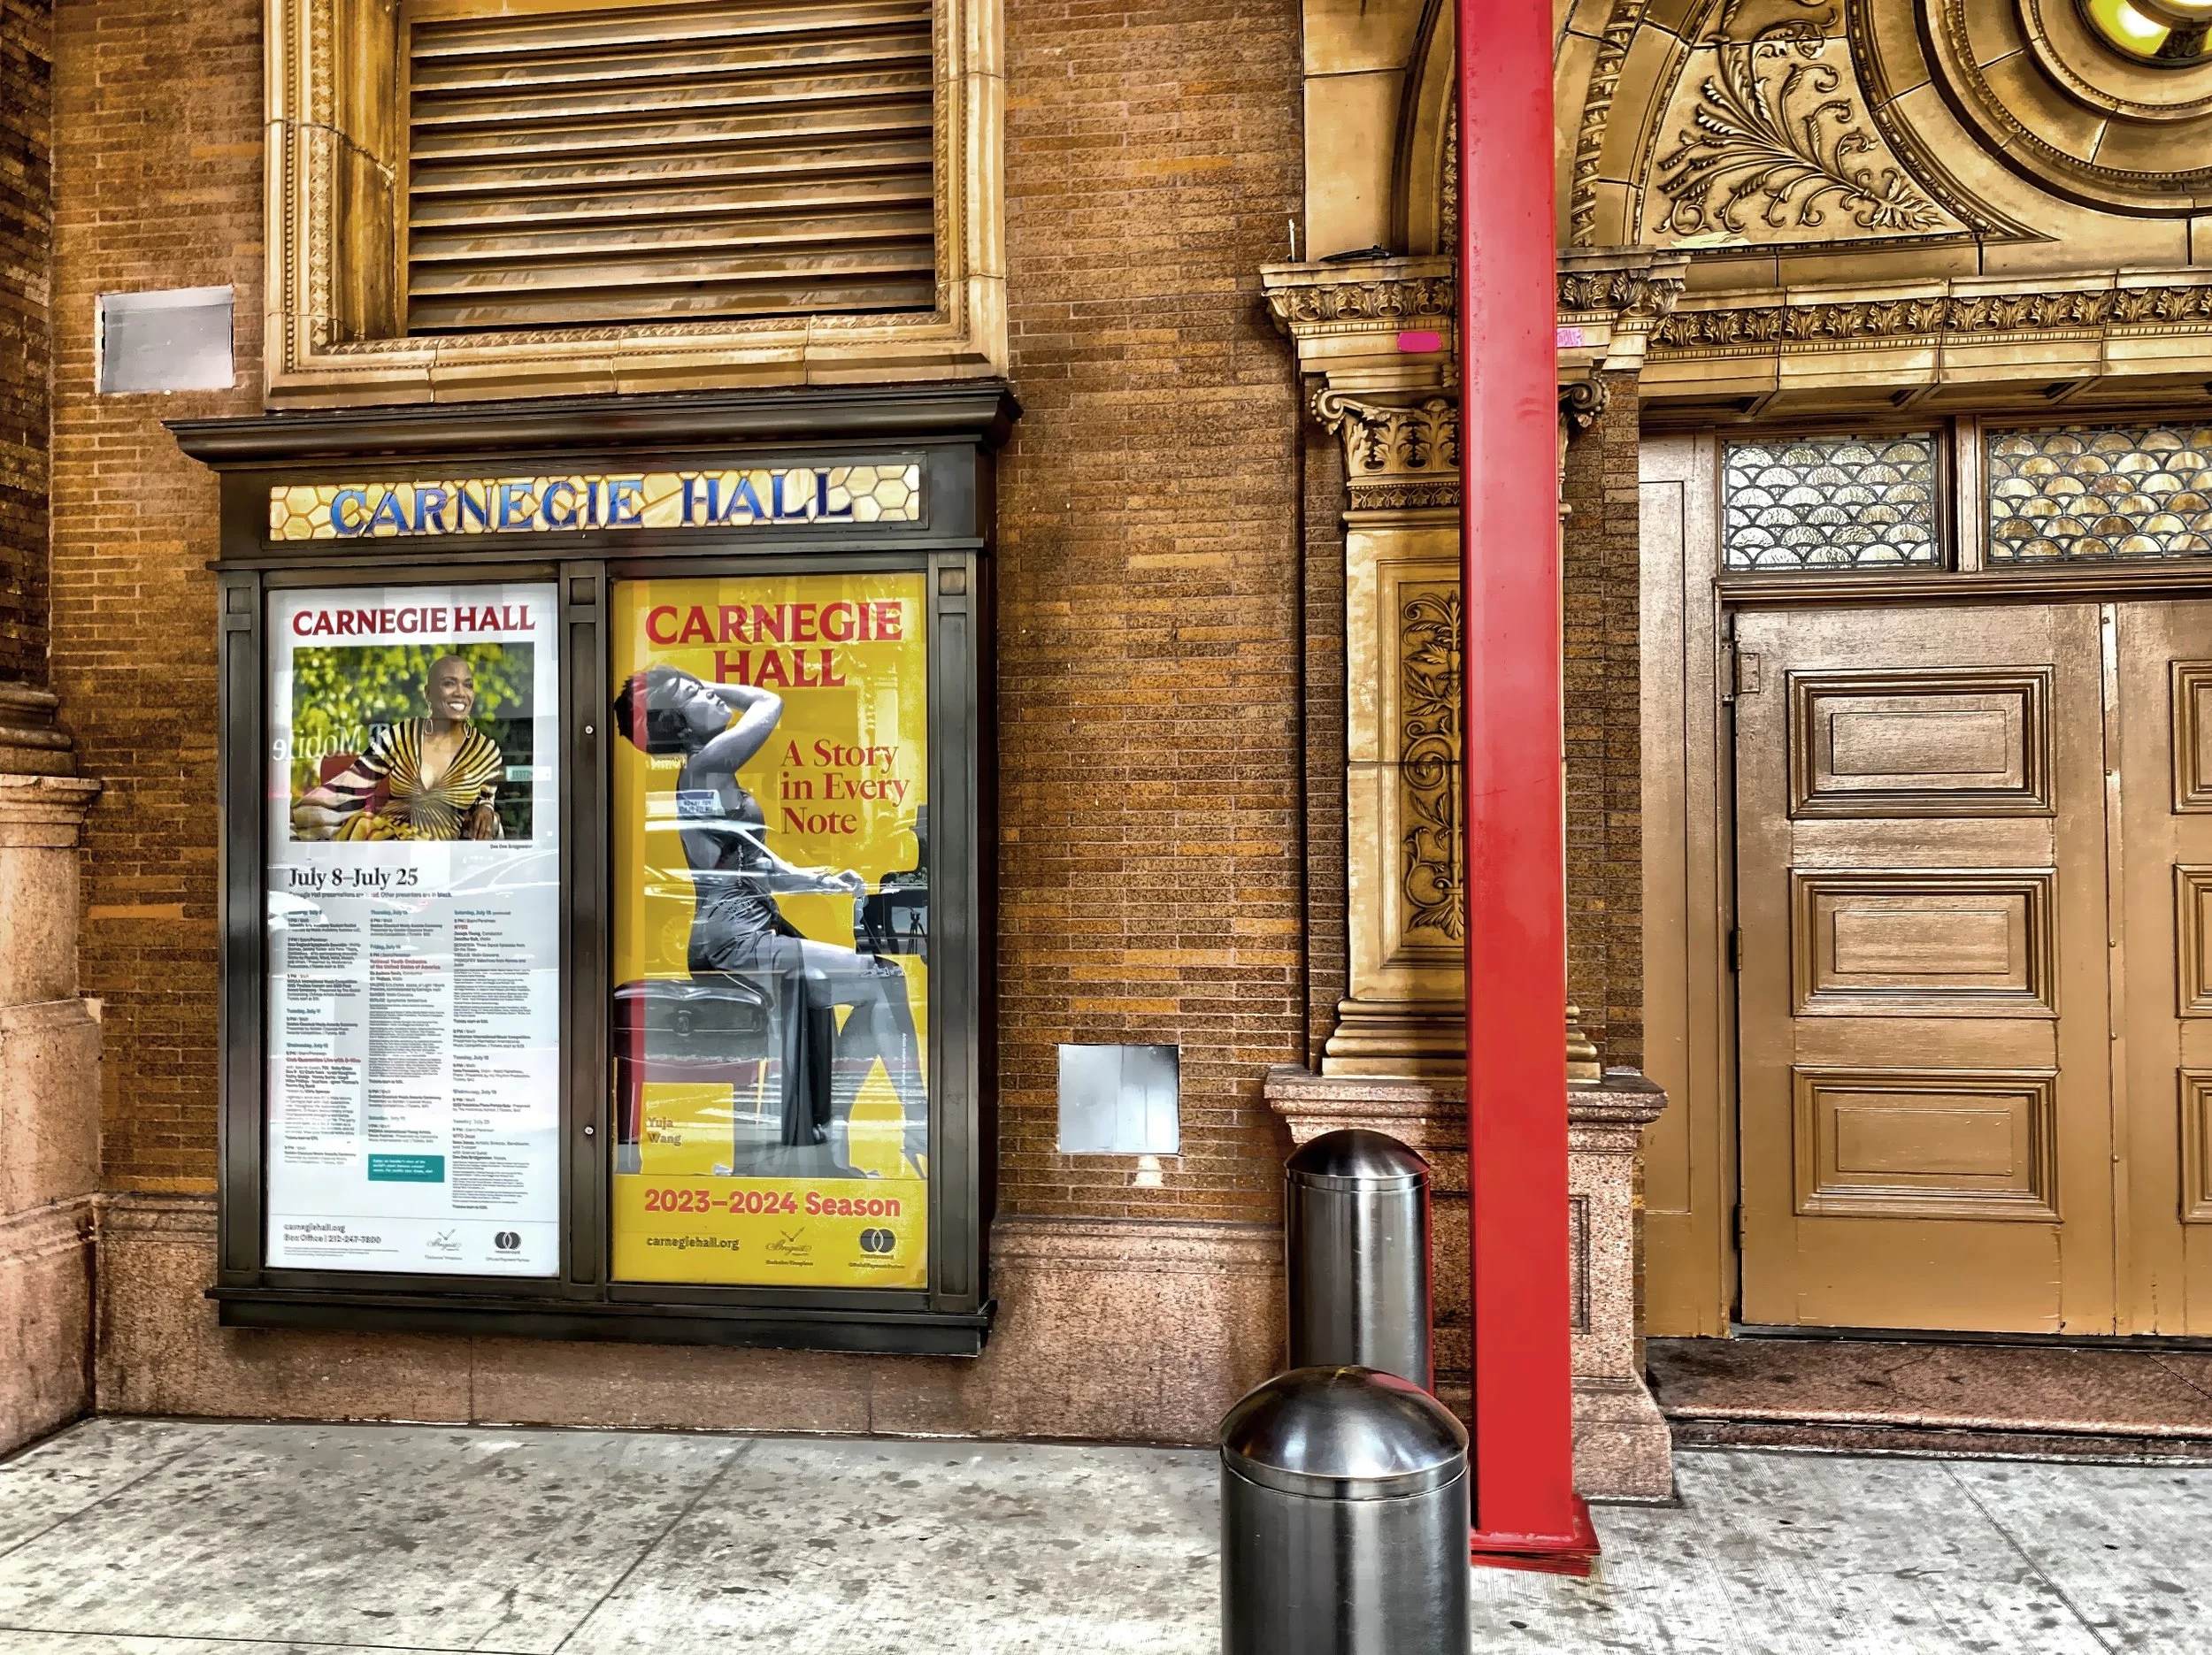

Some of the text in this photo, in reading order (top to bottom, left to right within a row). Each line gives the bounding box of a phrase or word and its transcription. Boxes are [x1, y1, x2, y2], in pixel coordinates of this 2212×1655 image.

[330, 472, 853, 535] CARNEGIE HALL
[292, 604, 536, 636] CARNEGIE HALL
[645, 601, 902, 645] CARNEGIE
[713, 647, 847, 688] HALL
[780, 739, 900, 774] A Story
[781, 771, 910, 808] in Every
[782, 807, 858, 835] Note
[289, 867, 419, 891] July 8–July 25
[648, 1116, 673, 1130] Yuja
[648, 1132, 682, 1146] Wang
[645, 1189, 901, 1217] 2023–2024 Season
[283, 1223, 346, 1233] carnegiehall.org
[647, 1236, 740, 1251] carnegiehall.org
